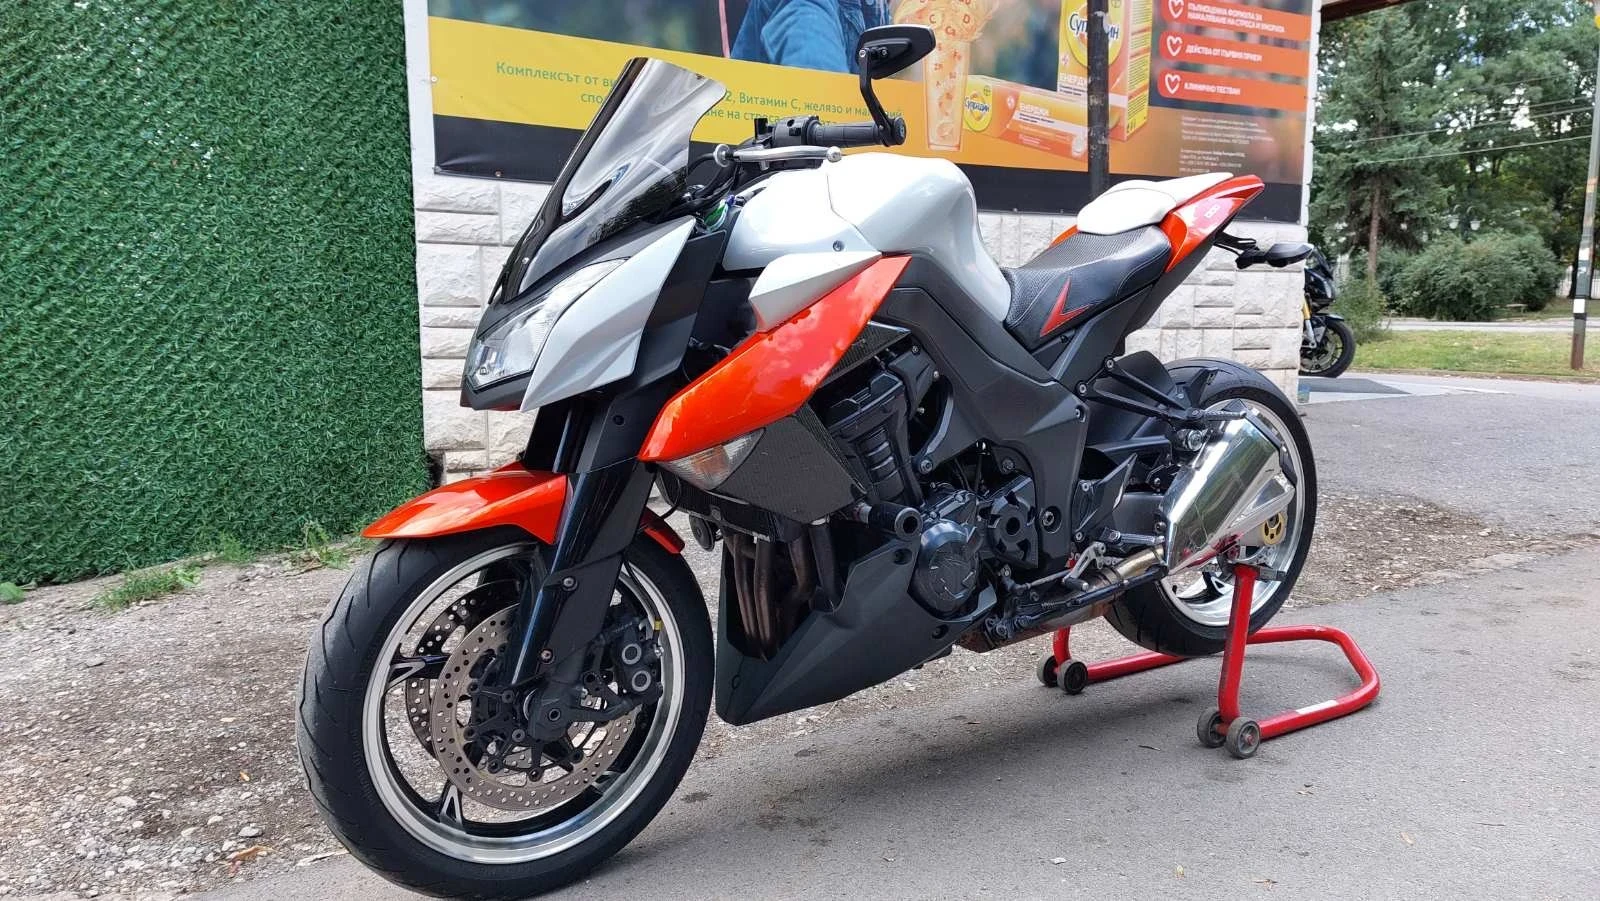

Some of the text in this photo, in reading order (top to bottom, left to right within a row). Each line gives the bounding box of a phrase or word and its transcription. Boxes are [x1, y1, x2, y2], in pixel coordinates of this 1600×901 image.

[496, 61, 582, 85] Комплексът
[584, 75, 599, 87] от
[739, 93, 788, 109] Витамин
[804, 102, 844, 115] желязо
[846, 107, 853, 115] и
[727, 111, 741, 120] на
